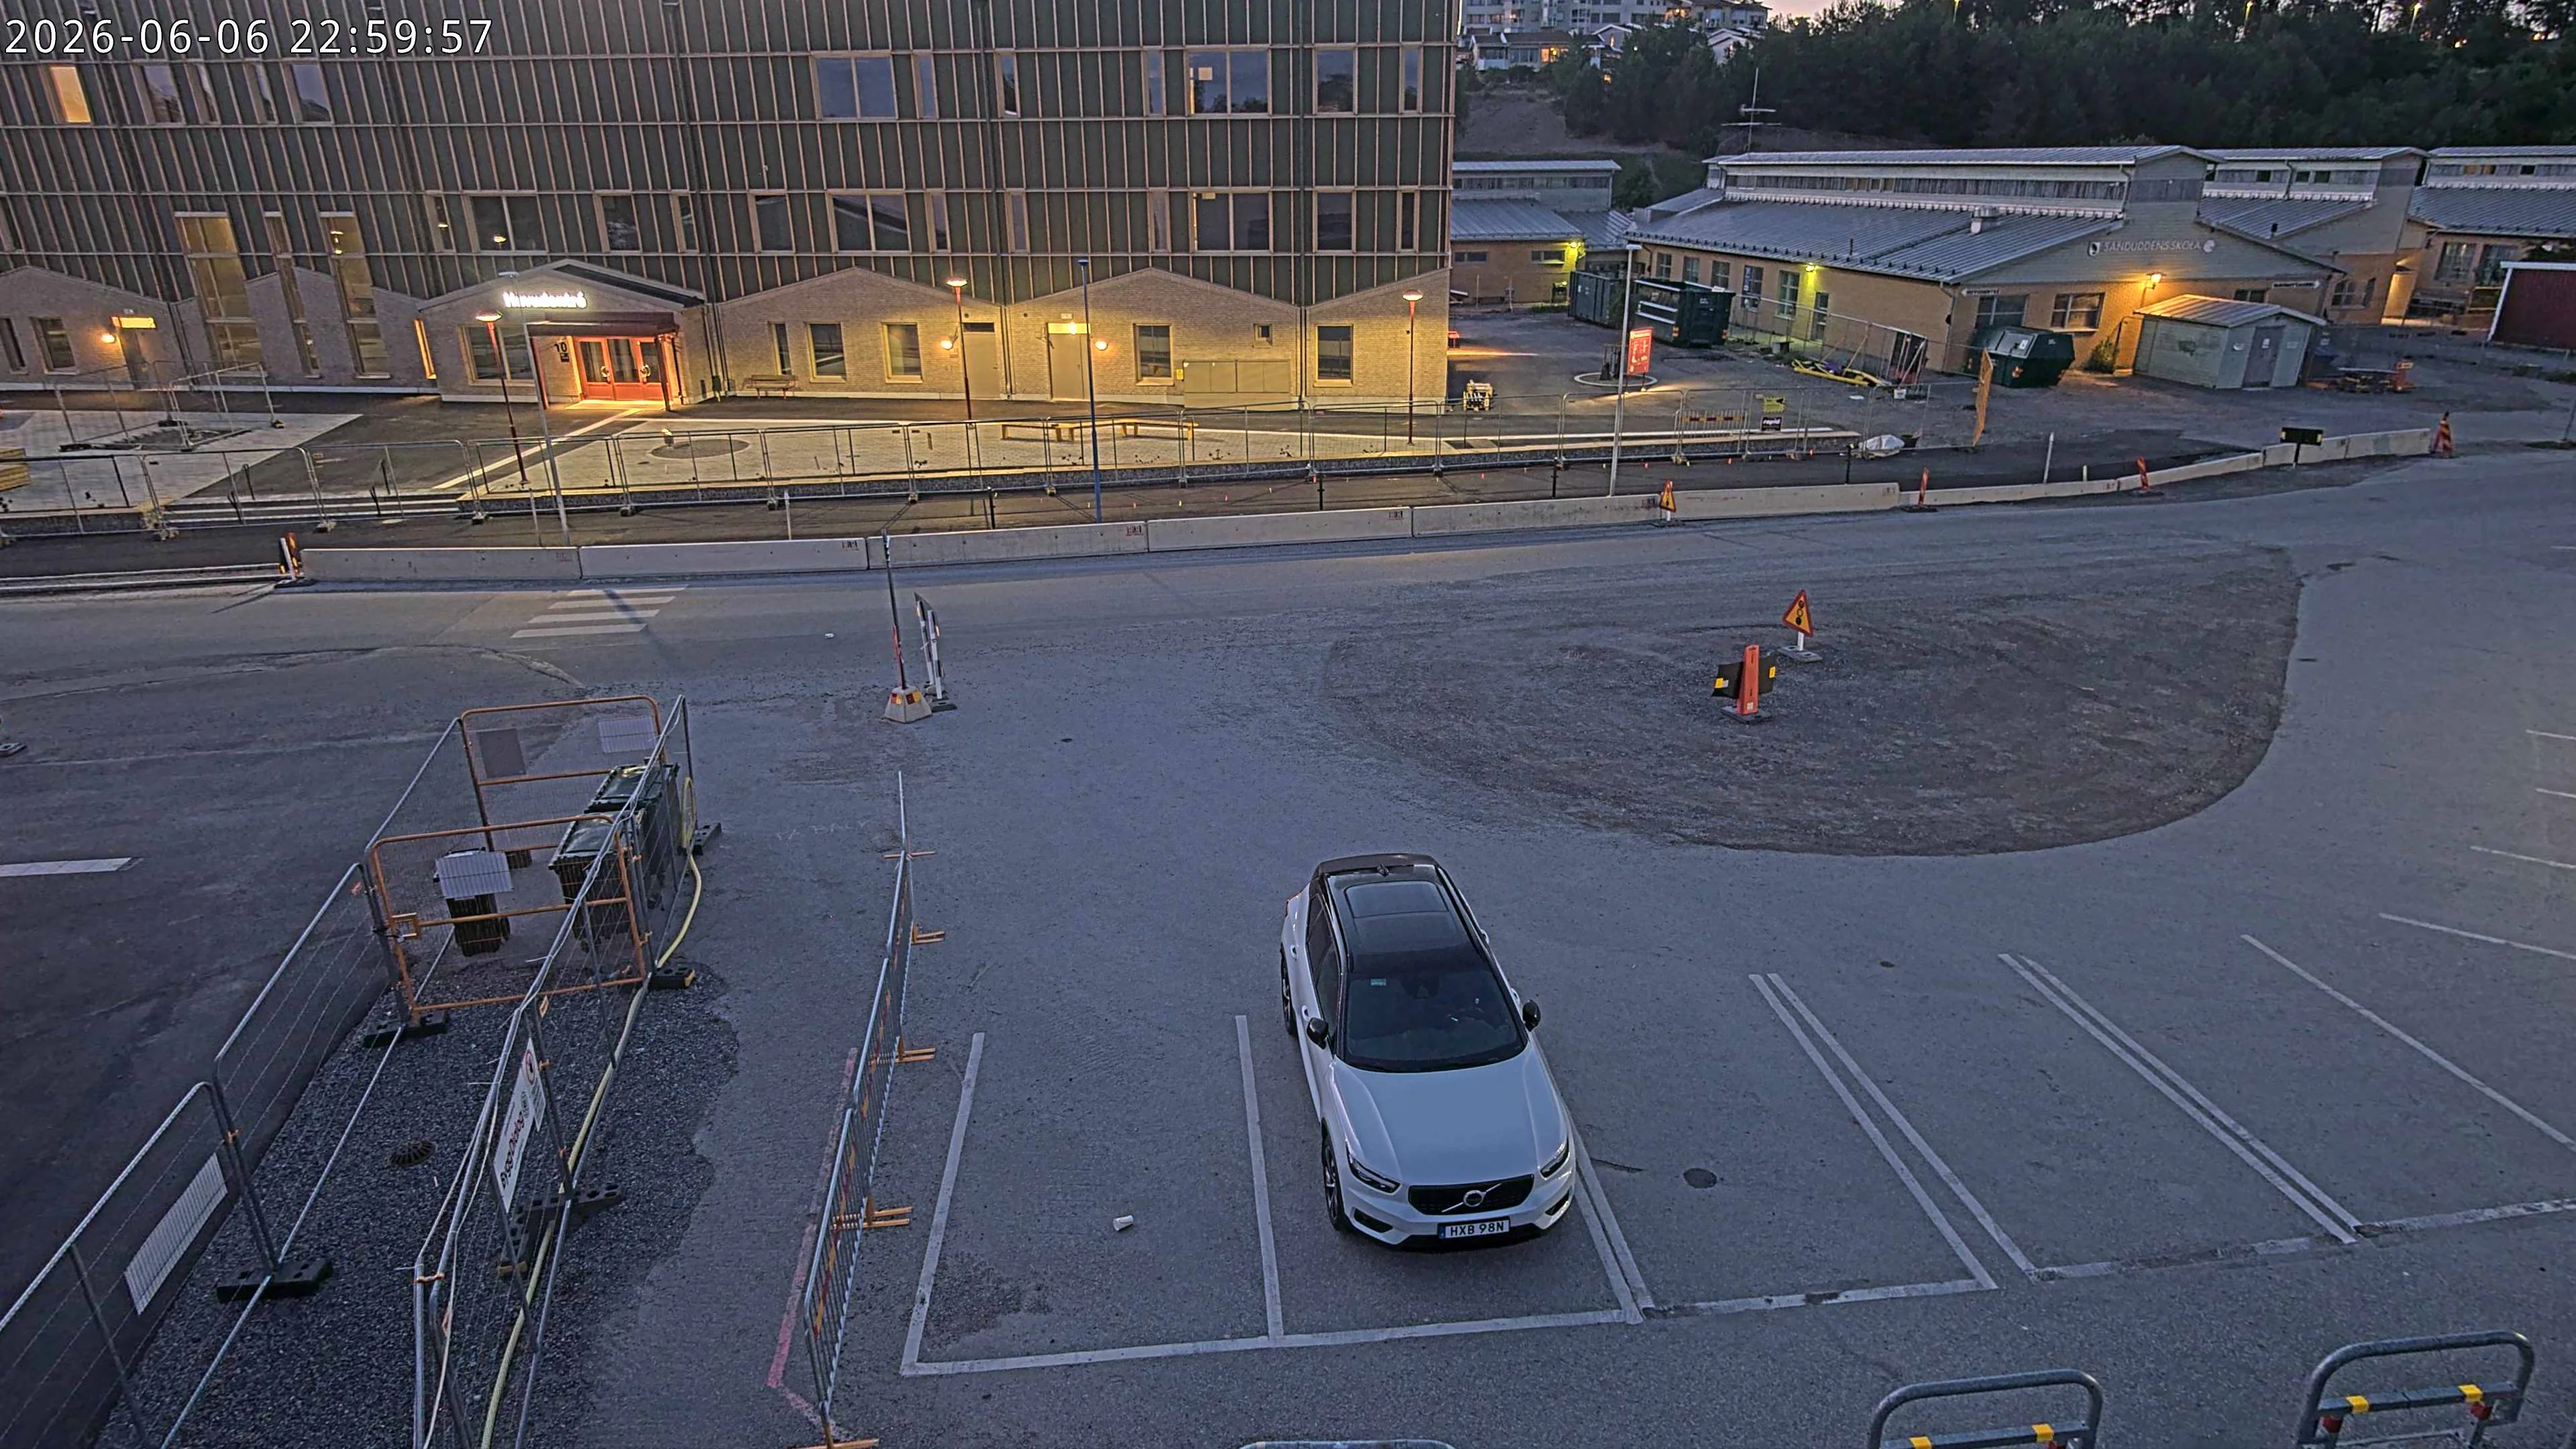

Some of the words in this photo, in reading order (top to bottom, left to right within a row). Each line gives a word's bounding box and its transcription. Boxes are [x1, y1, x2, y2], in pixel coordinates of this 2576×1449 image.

[554, 342, 567, 352] 10
[1450, 1225, 1474, 1236] HXB
[1479, 1222, 1503, 1234] 98N
